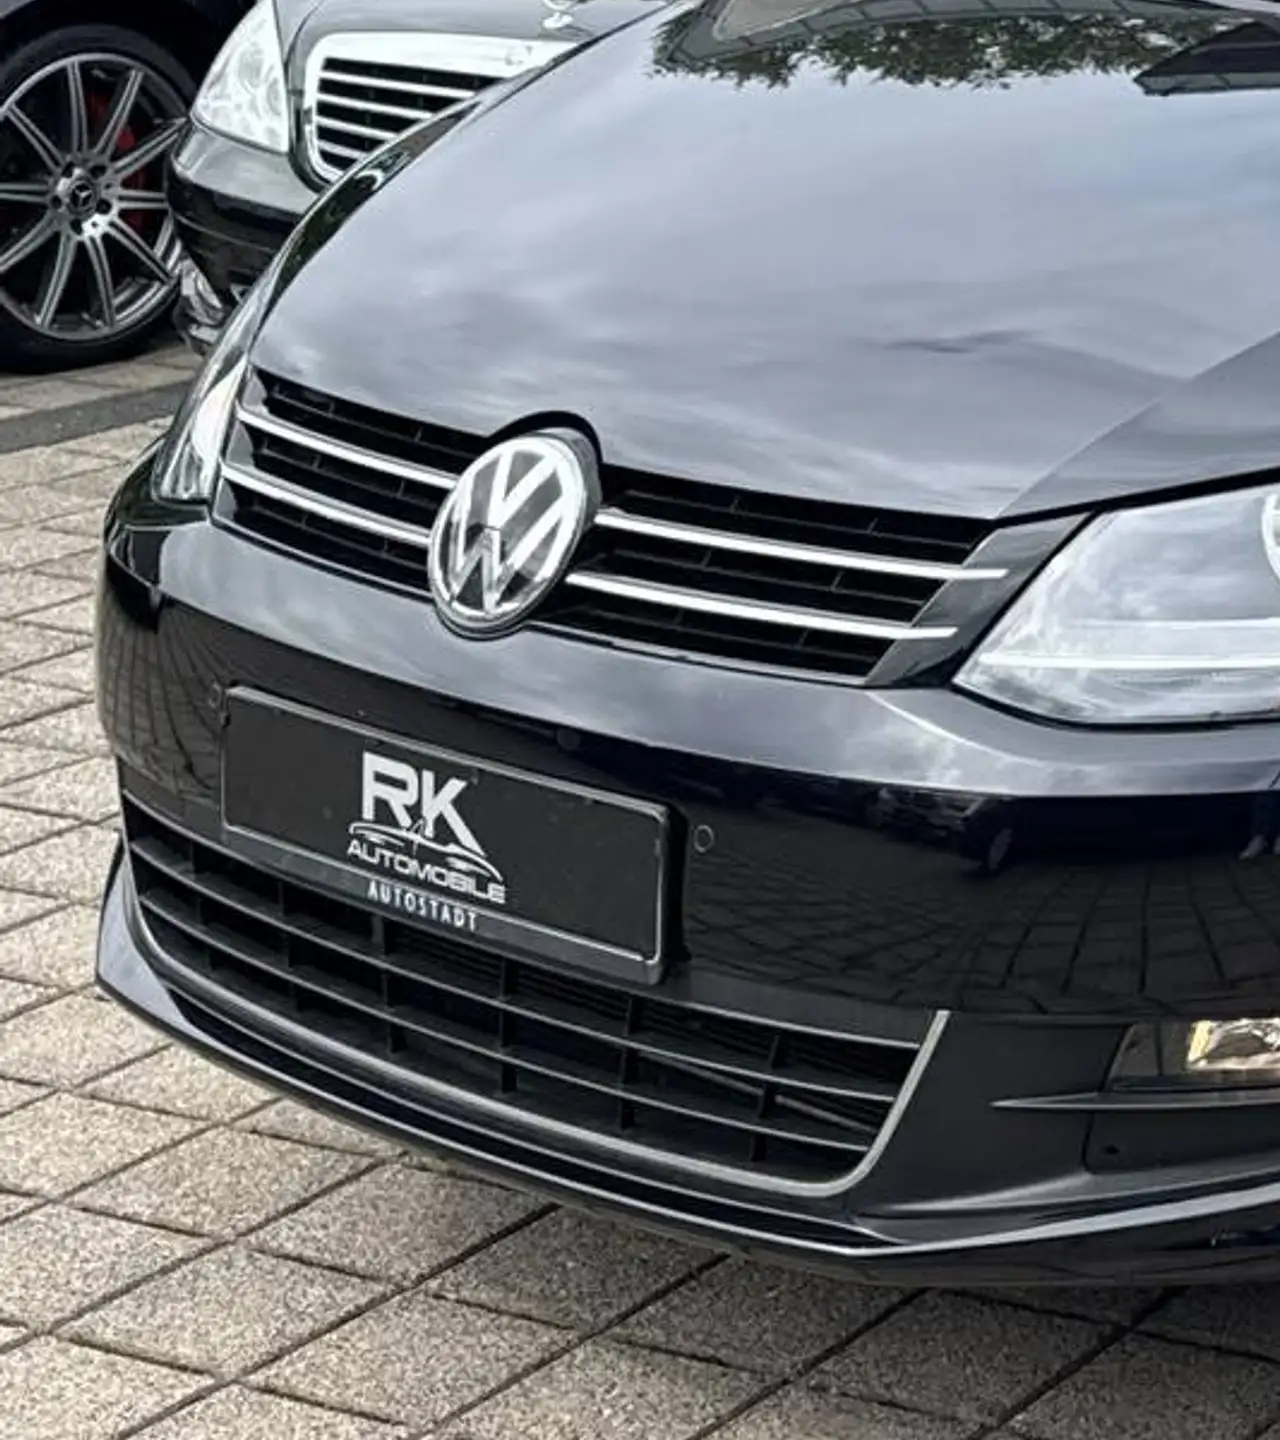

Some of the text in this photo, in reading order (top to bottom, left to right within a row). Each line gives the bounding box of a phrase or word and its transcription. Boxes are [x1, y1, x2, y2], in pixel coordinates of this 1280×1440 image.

[362, 751, 487, 858] RK
[347, 839, 506, 904] AUTOMOBILE
[367, 879, 478, 931] AUTOSTADT
